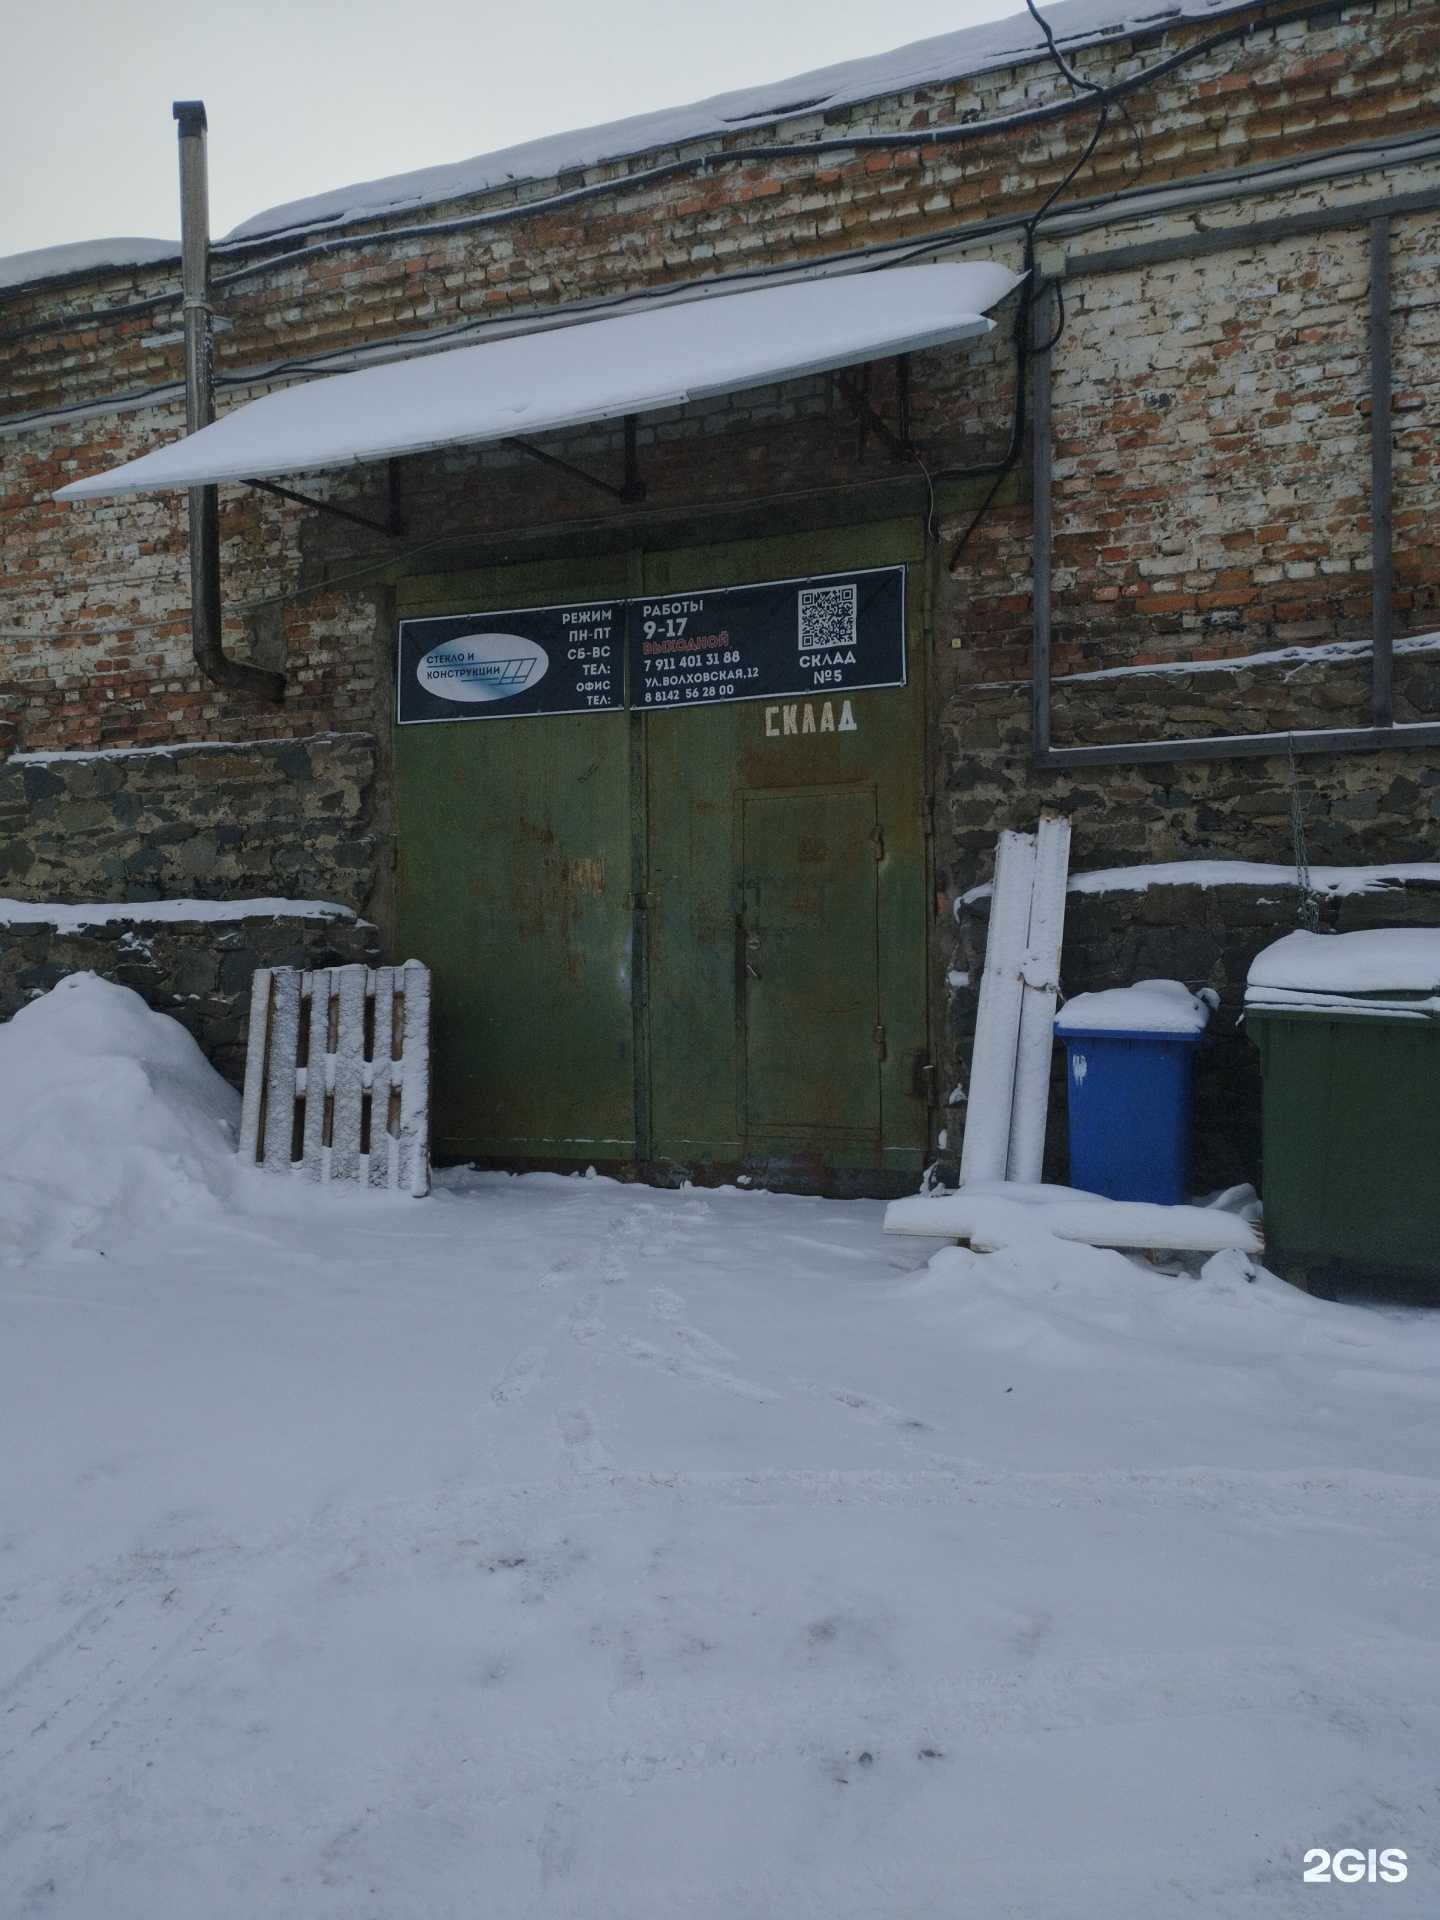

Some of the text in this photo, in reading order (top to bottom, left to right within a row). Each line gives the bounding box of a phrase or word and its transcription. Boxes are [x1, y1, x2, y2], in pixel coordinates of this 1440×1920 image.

[562, 600, 704, 624] РЕЖИМ РАБОТЫ
[569, 618, 688, 642] ПН-ПТ 9-17
[567, 631, 729, 660] СБ-ВС ВЫХОДНОЙ
[426, 653, 474, 664] СТЕКЛО И
[582, 651, 740, 675] ТЕЛ: 7 911 401 31 88
[799, 650, 857, 669] СКЛАД
[427, 667, 500, 680] КОНСТРУКЦИИ
[576, 681, 611, 693] ОФИС
[587, 685, 734, 705] ТЕЛ: 8 8142 56 28 00
[765, 700, 858, 737] СКЛАД
